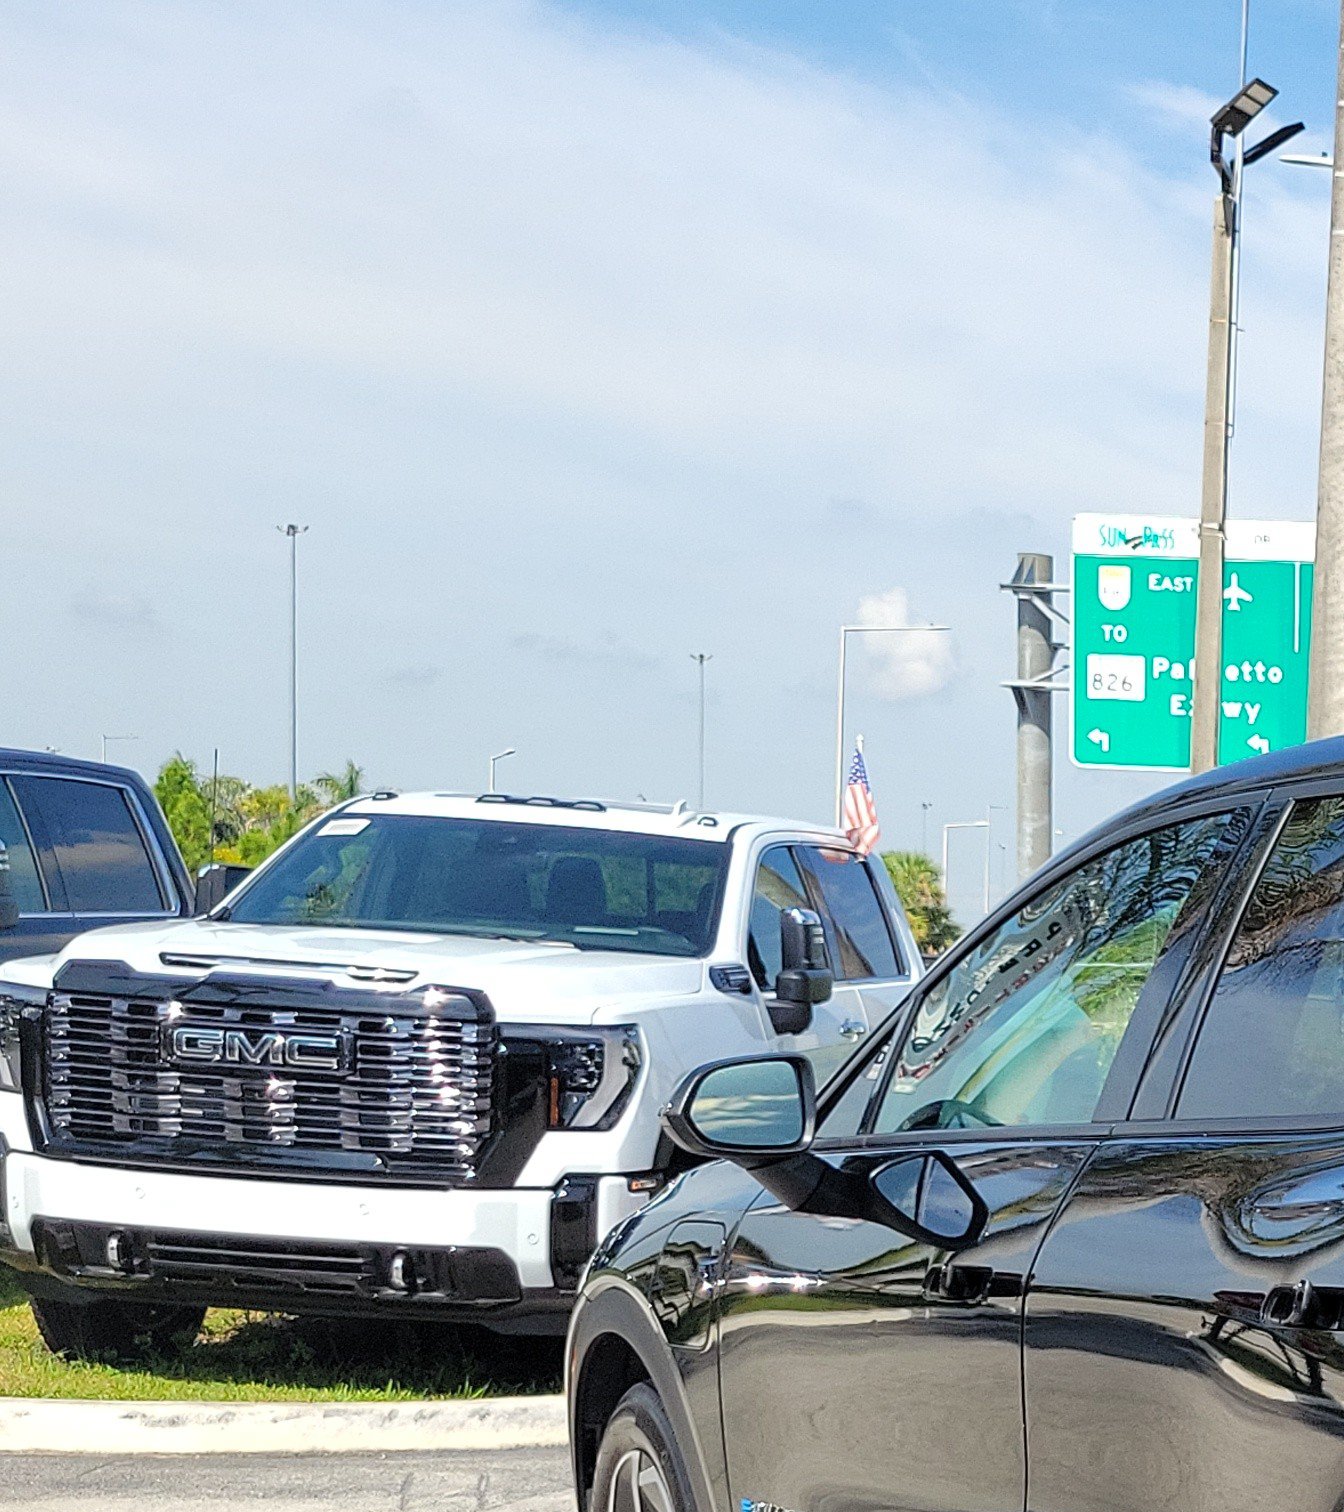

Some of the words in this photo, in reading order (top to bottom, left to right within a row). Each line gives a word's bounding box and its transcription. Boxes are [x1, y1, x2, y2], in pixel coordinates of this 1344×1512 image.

[1148, 573, 1194, 592] EAST
[1101, 624, 1128, 643] TO
[1092, 673, 1133, 692] 826
[1152, 656, 1283, 684] Paletto
[173, 1027, 338, 1070] GMC
